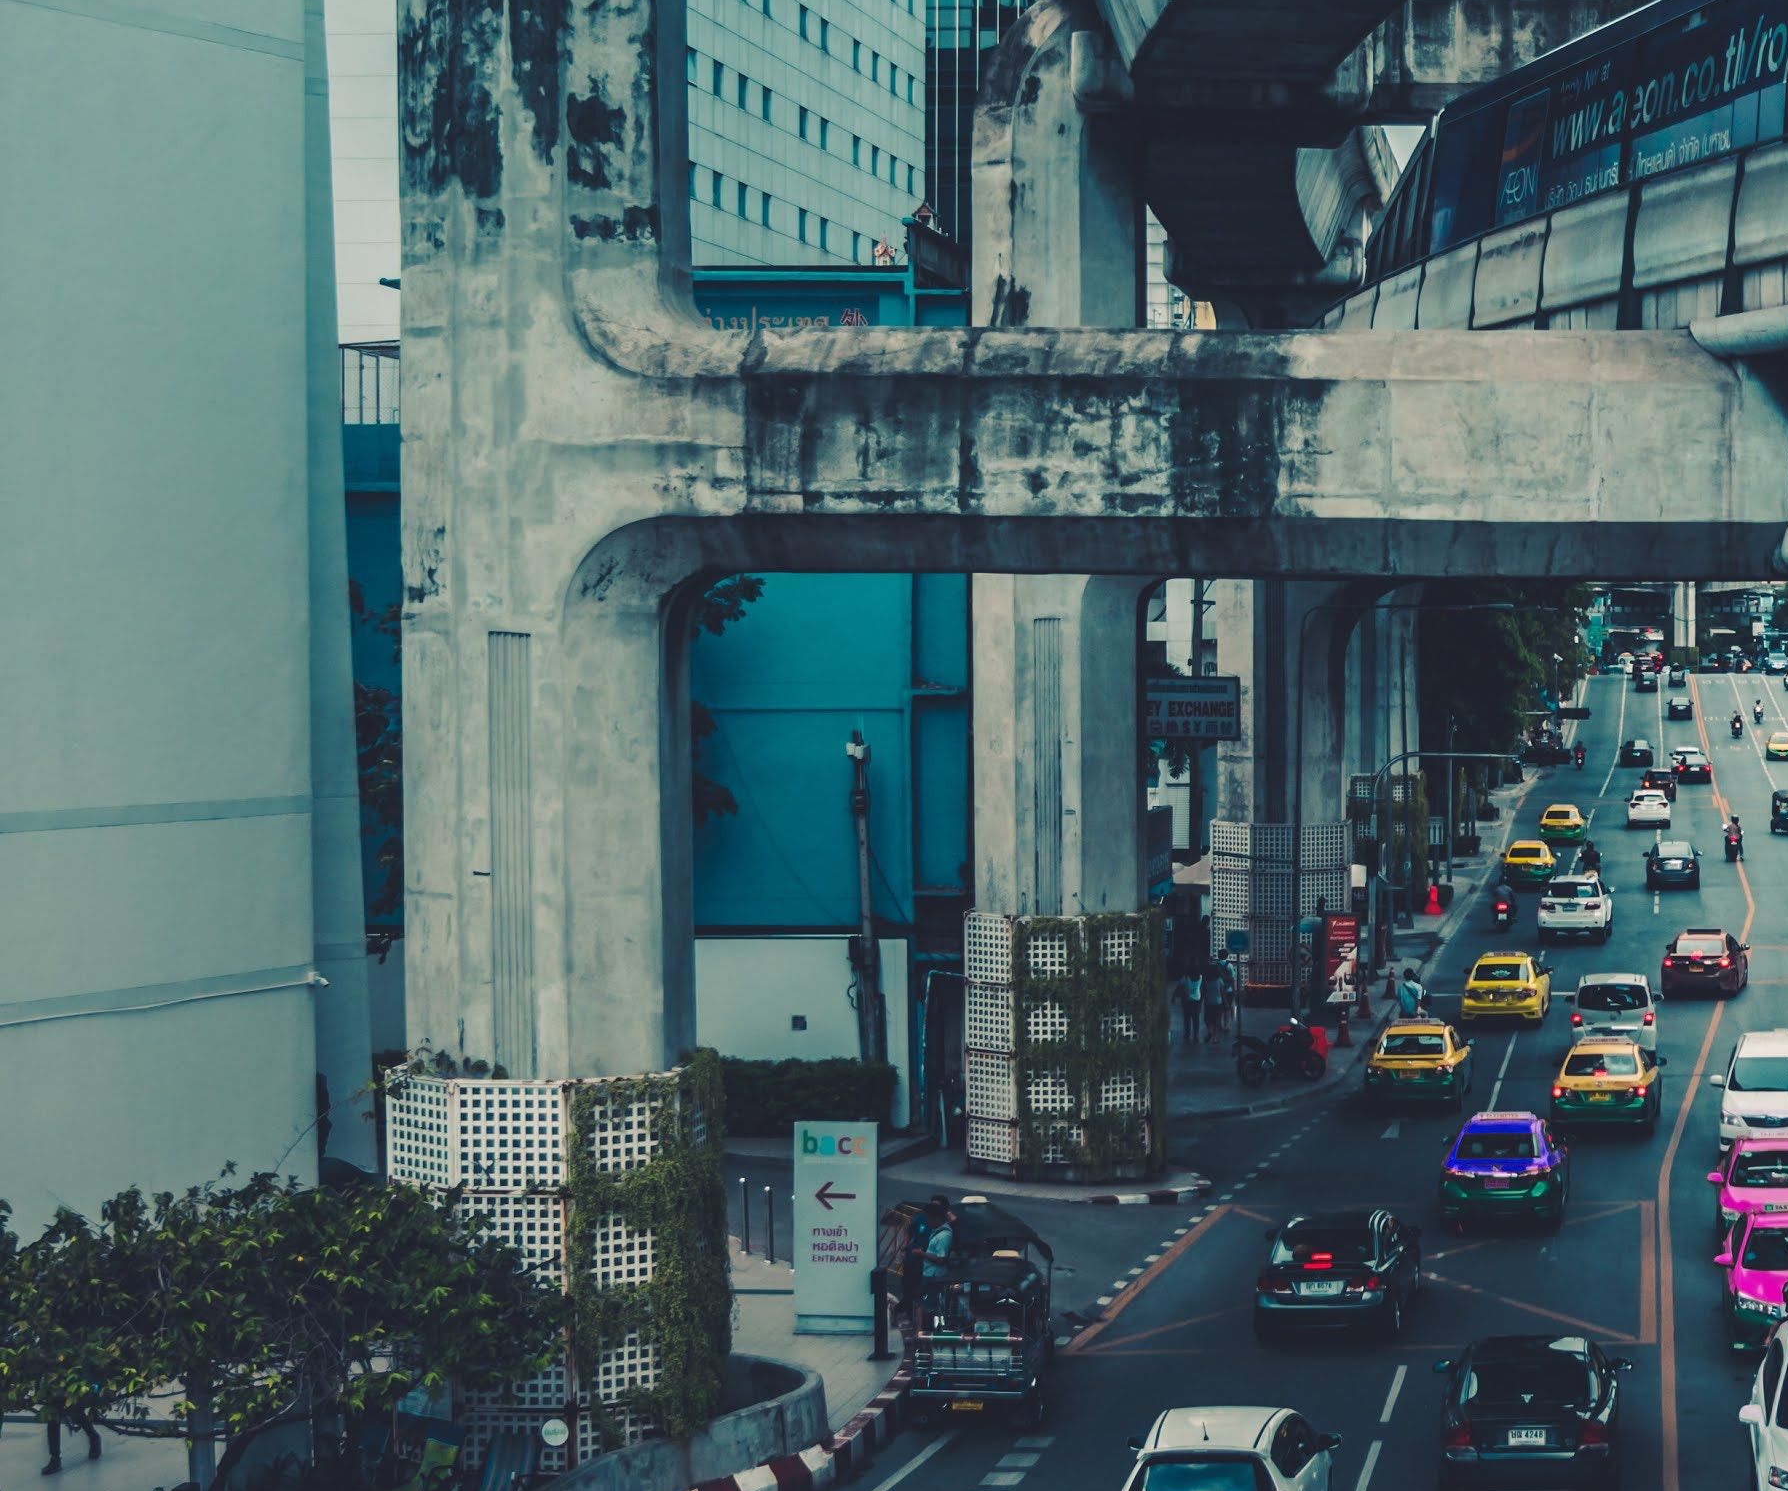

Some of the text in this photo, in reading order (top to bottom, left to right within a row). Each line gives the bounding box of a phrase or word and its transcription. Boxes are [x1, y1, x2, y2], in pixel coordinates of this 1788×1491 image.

[1168, 701, 1235, 717] EXCHANGE
[803, 1129, 867, 1156] bacc
[812, 1225, 848, 1237] ทางเข้า
[812, 1255, 858, 1263] ENTRANCE
